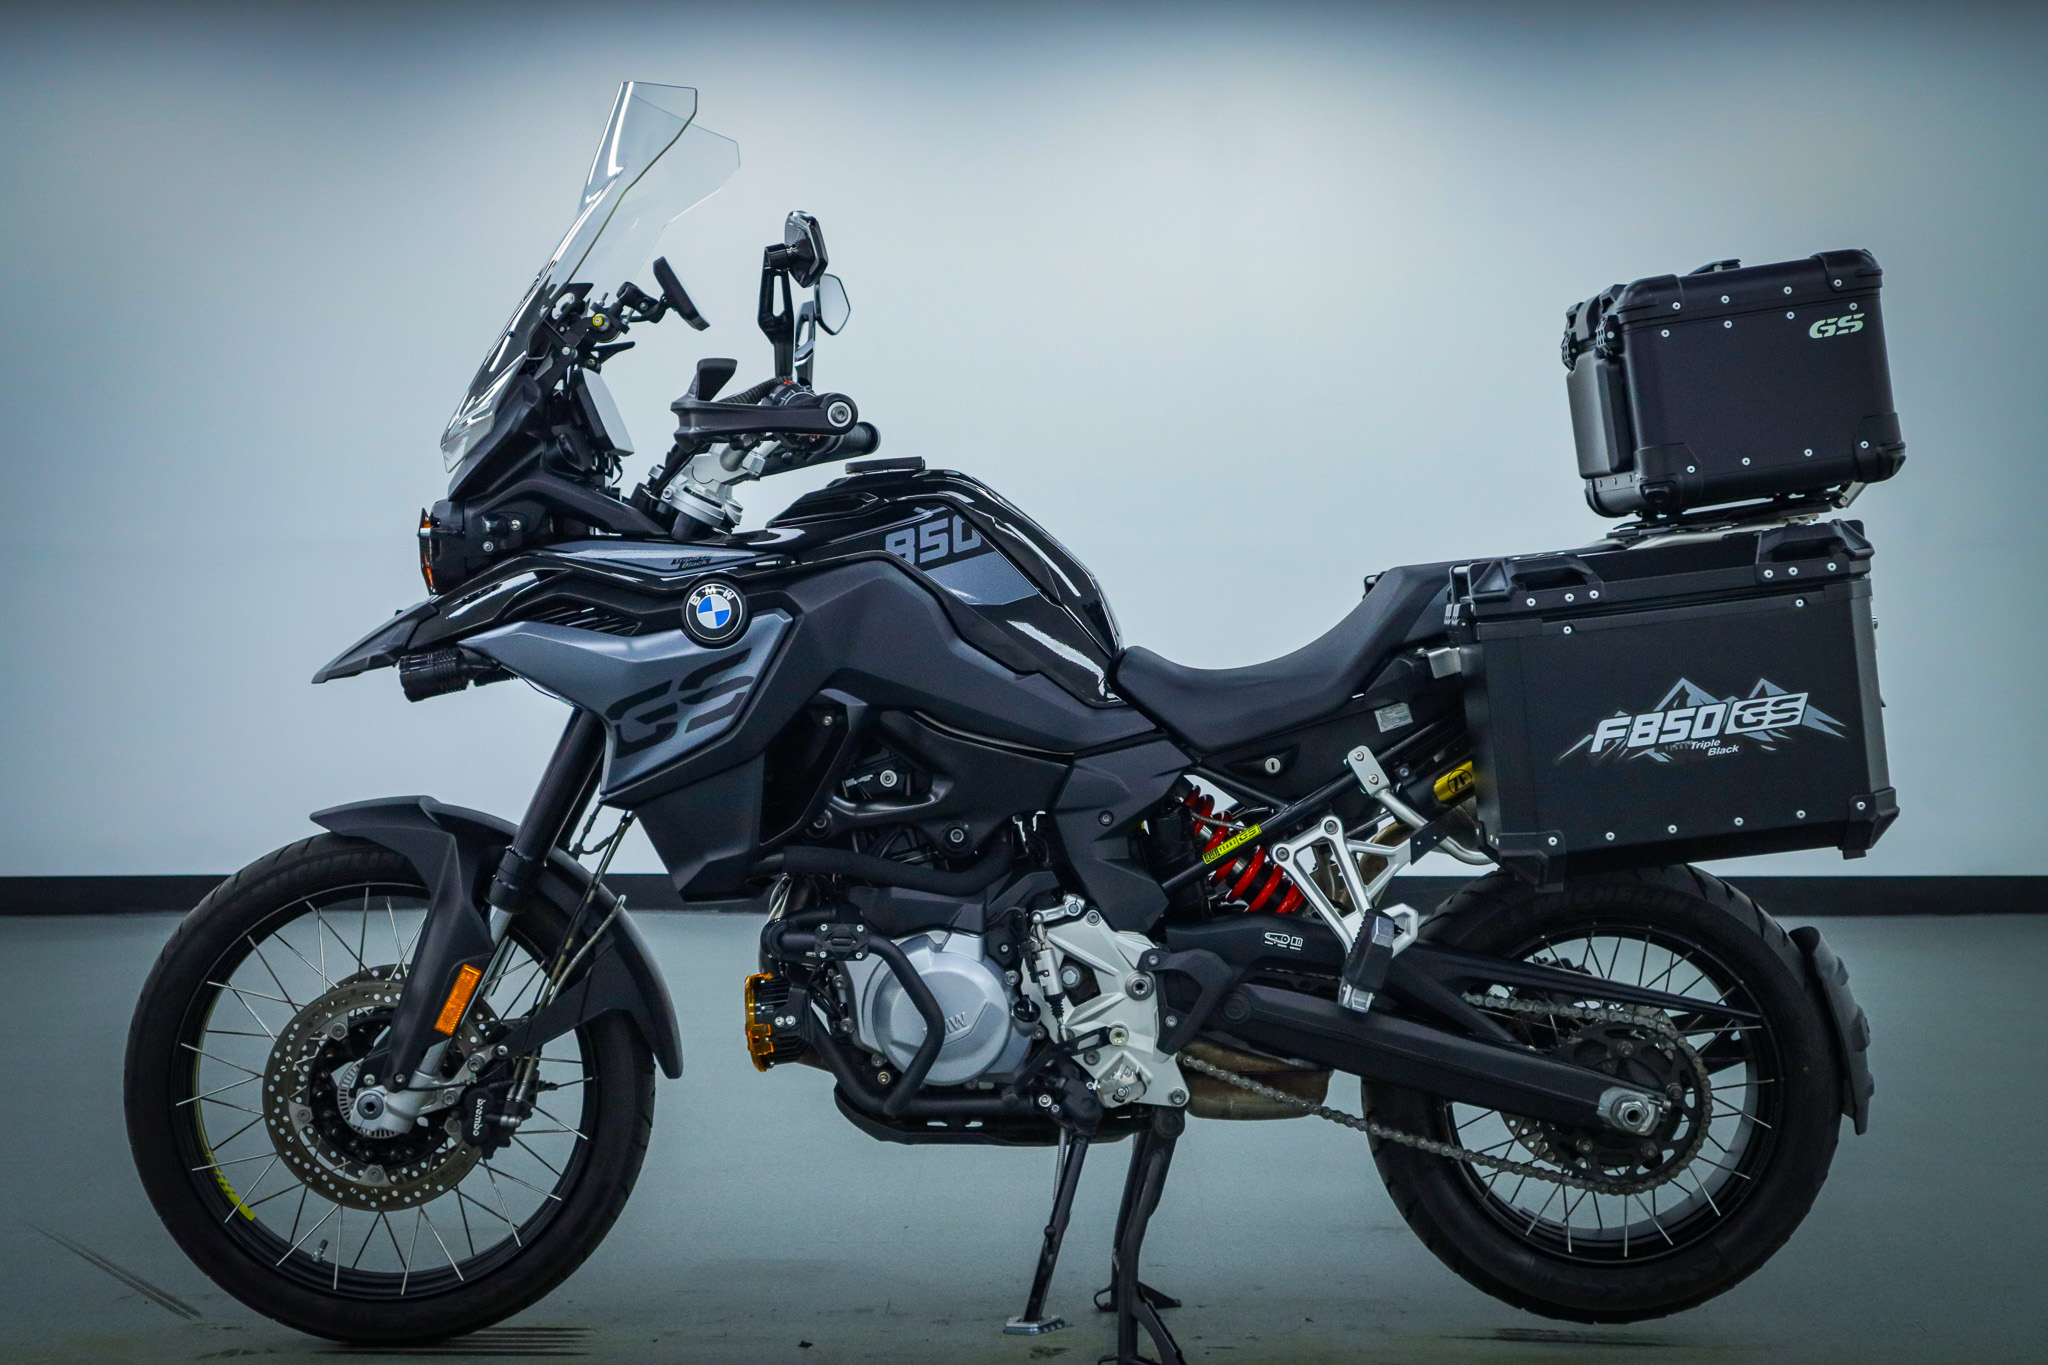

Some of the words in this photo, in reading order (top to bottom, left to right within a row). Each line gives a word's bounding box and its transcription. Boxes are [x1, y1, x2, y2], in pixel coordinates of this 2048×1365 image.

[1809, 312, 1865, 339] GS
[689, 585, 735, 606] BMW
[604, 648, 756, 759] GS
[1690, 738, 1721, 750] Triple
[1707, 744, 1740, 756] Black
[472, 1098, 486, 1137] brembo
